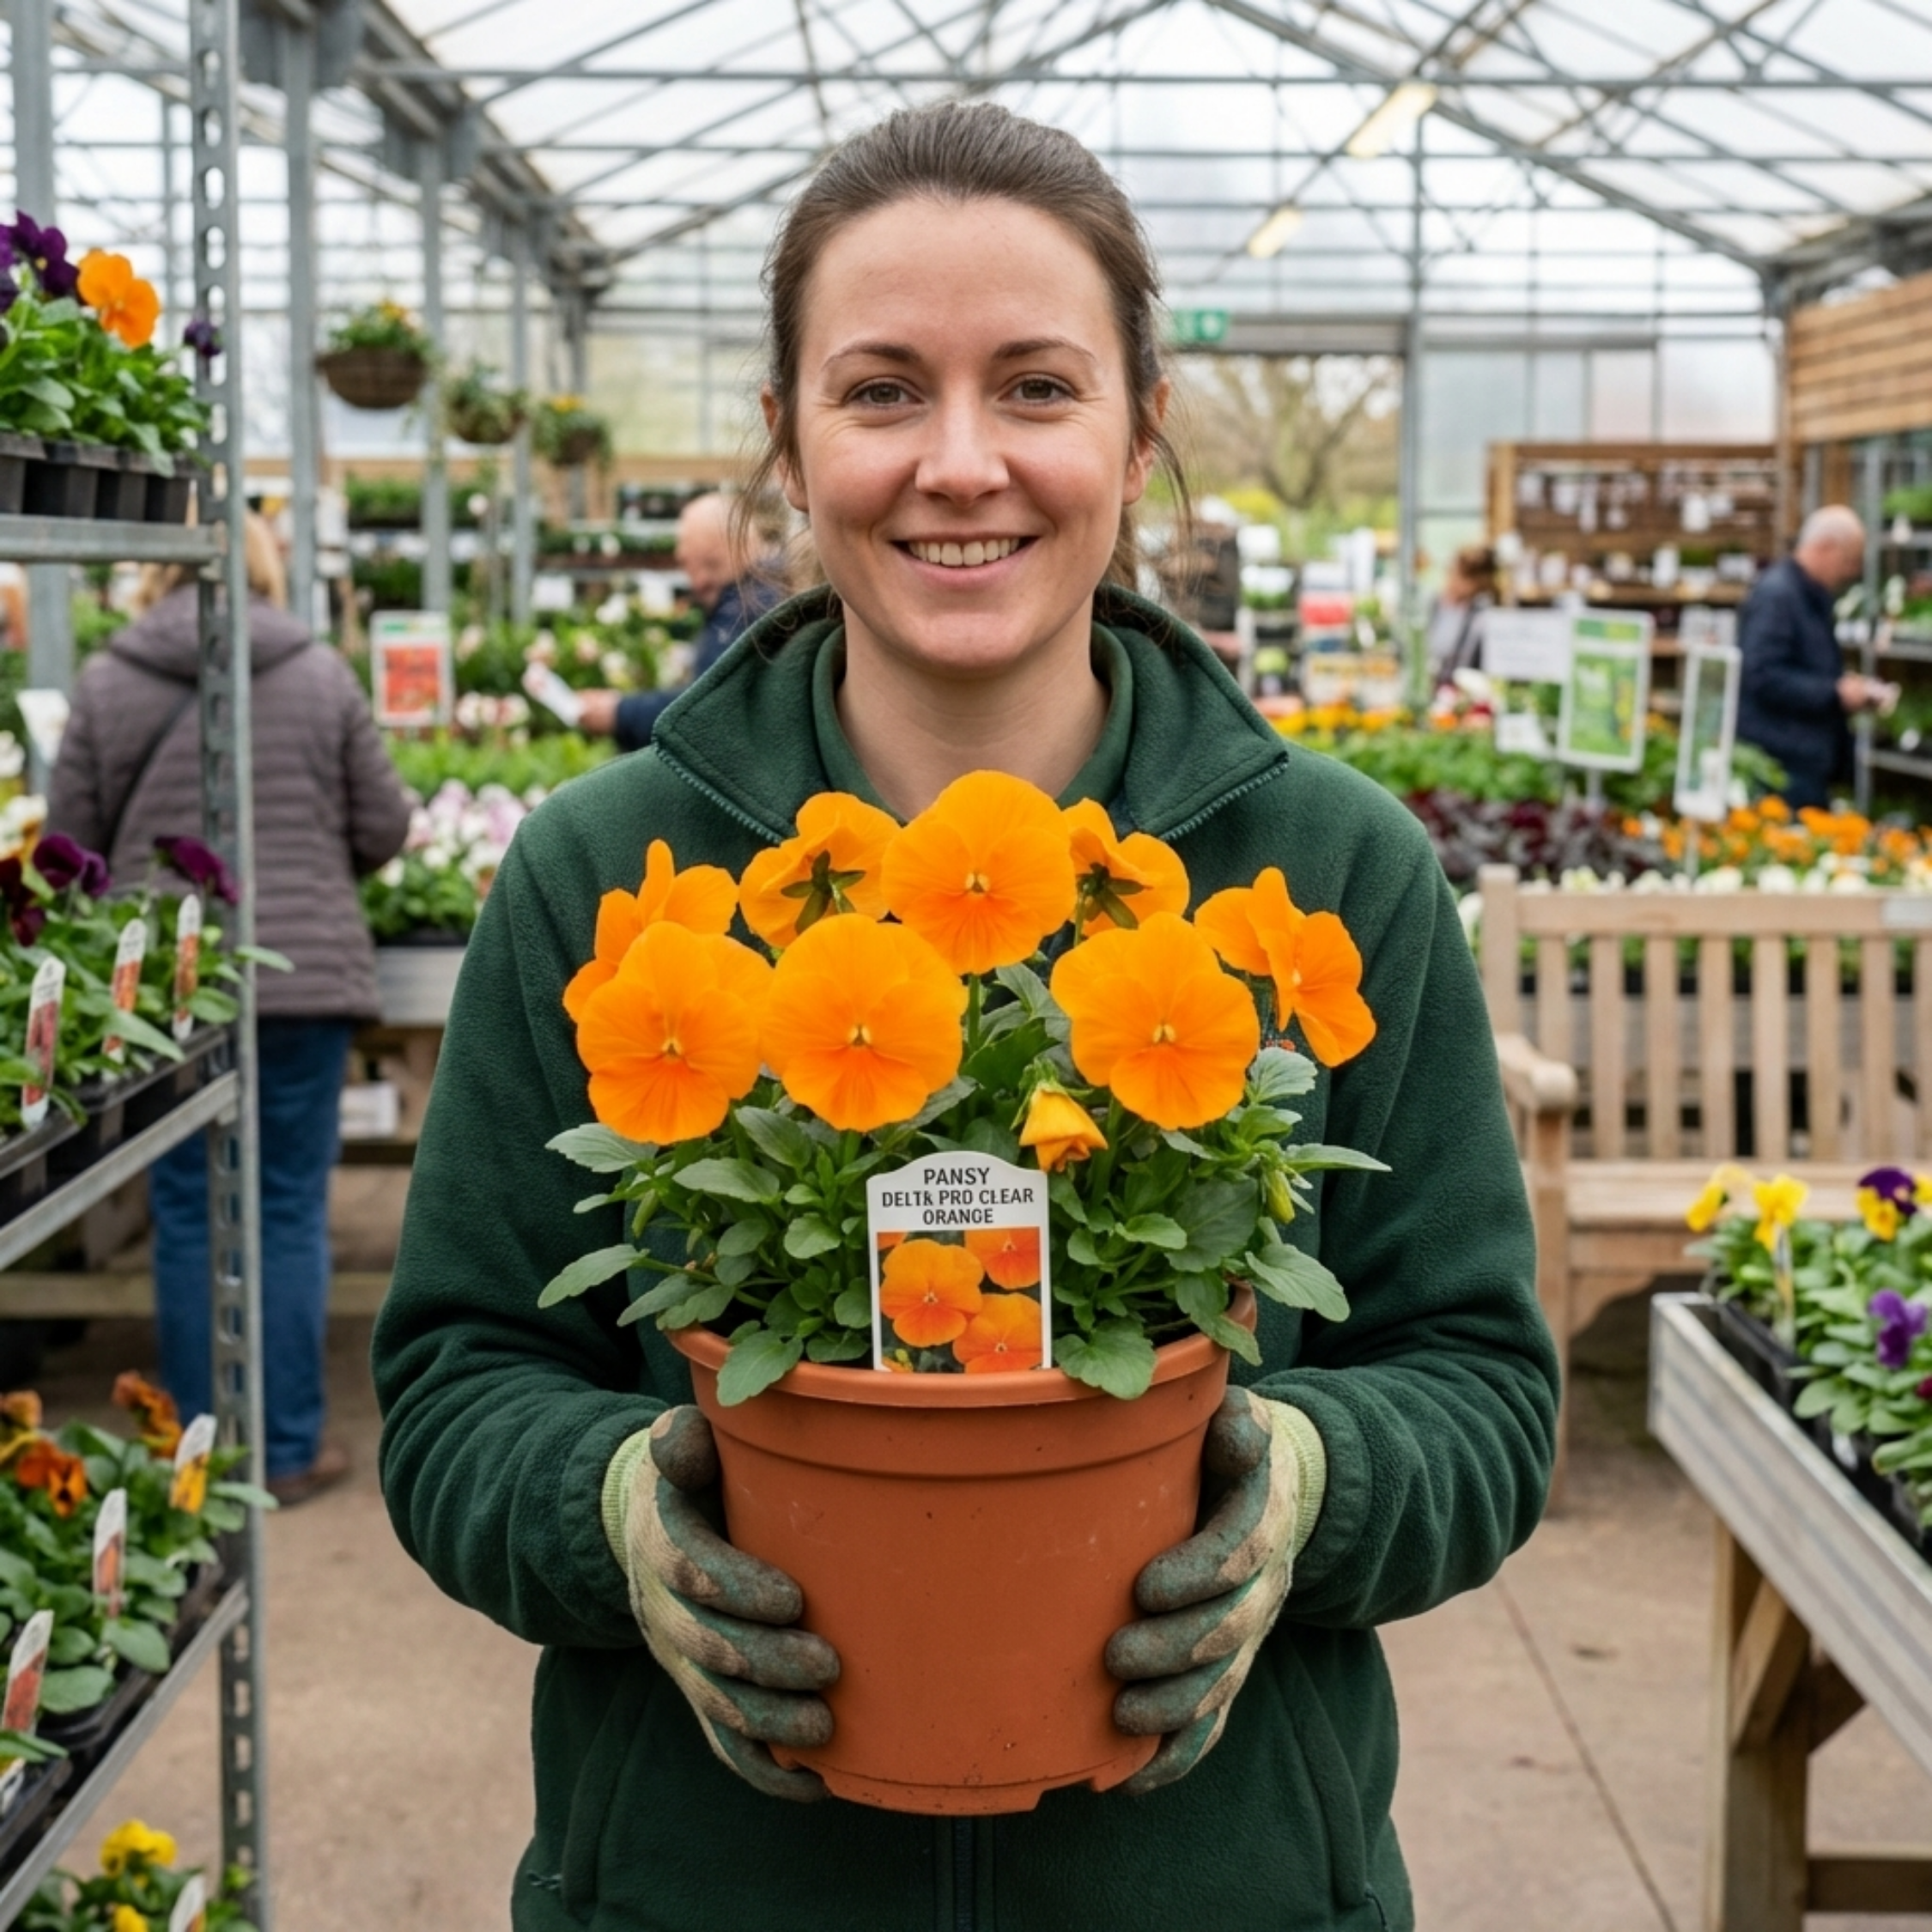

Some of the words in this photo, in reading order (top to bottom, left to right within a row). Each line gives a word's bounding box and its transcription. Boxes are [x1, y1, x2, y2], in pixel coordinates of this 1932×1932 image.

[923, 1167, 990, 1185] PANSY
[939, 1189, 973, 1205] PRO
[979, 1188, 1034, 1204] CLEAR
[922, 1208, 993, 1224] ORANGE
